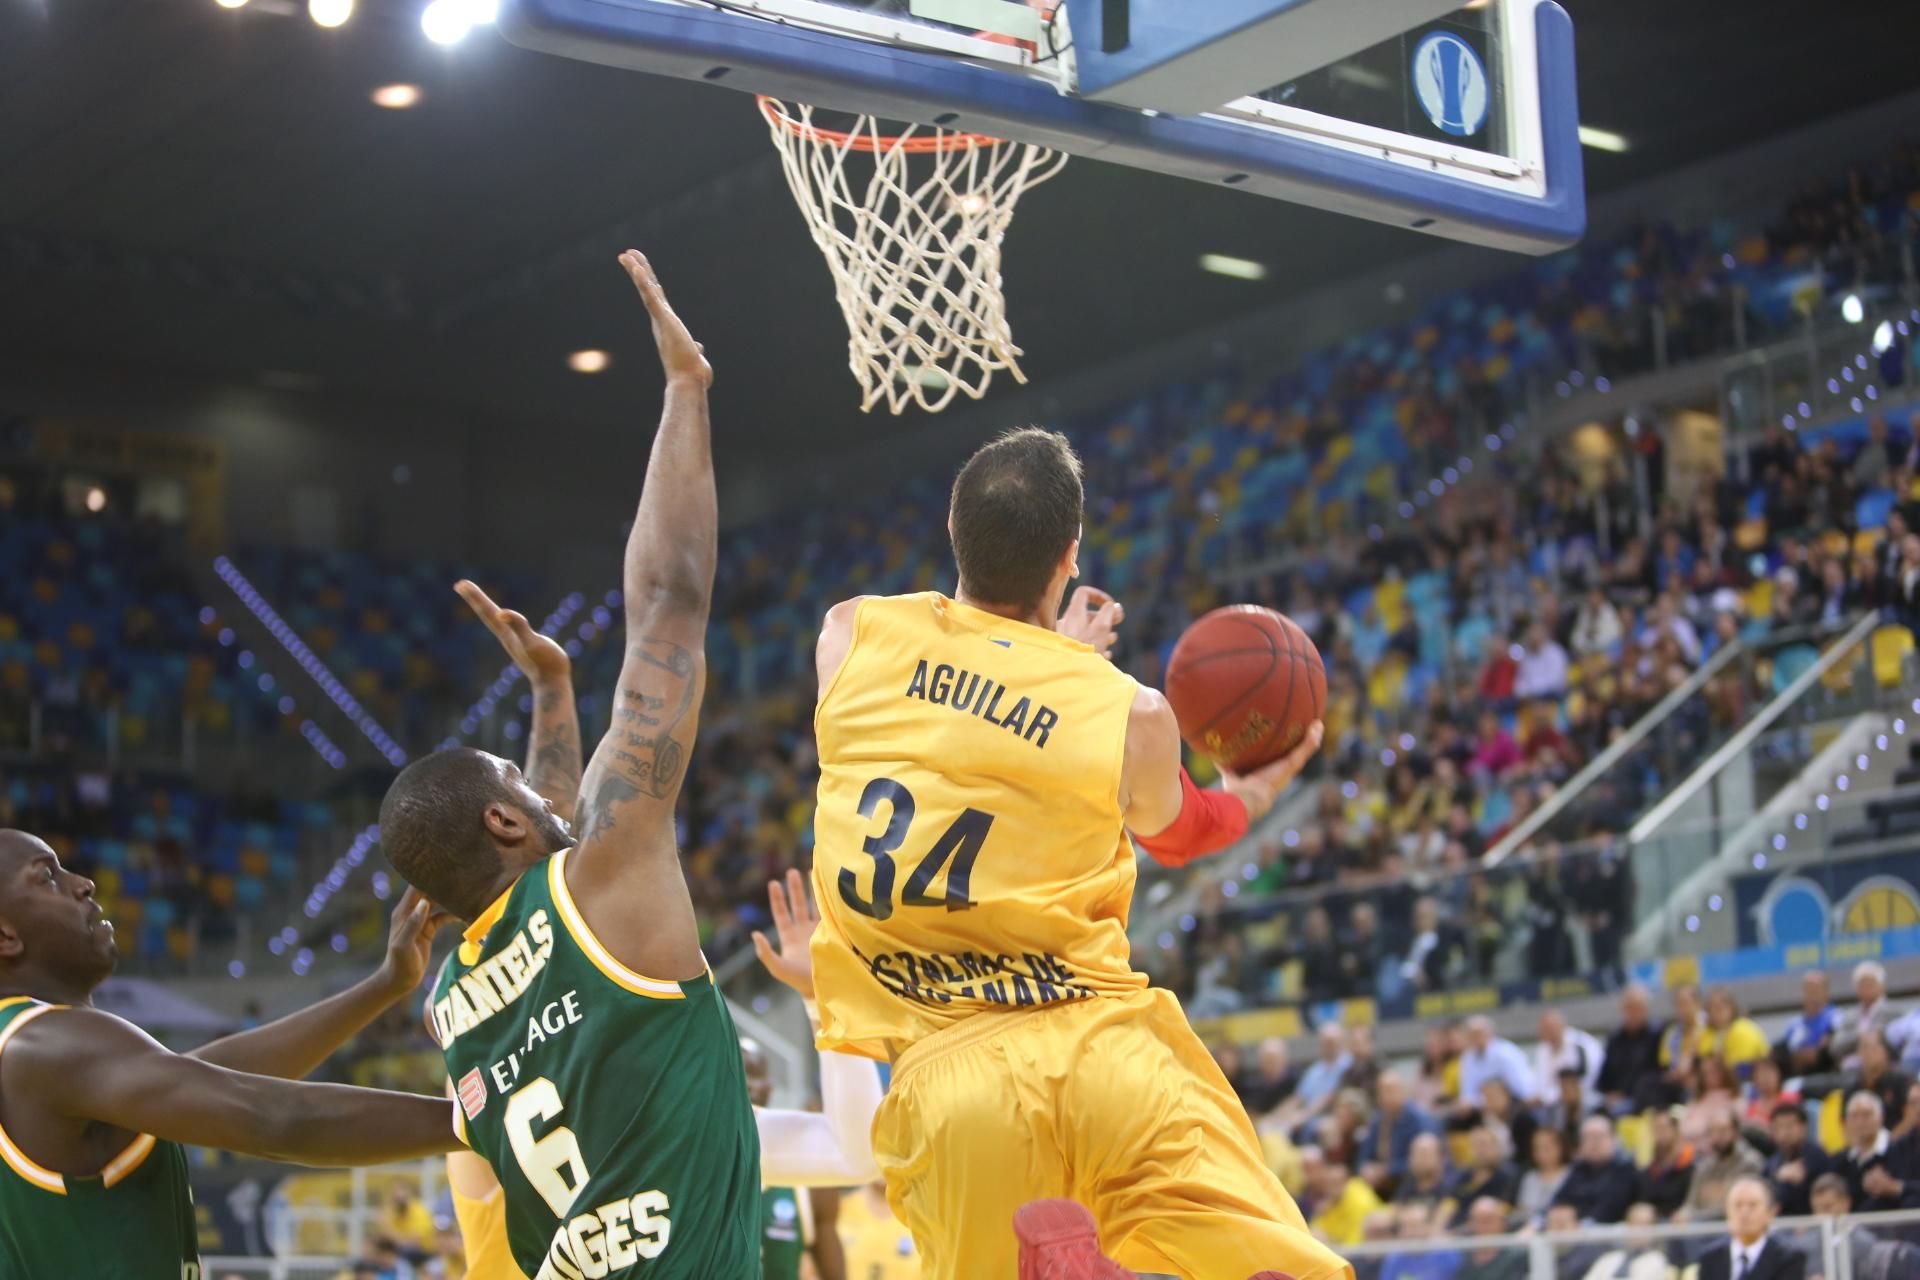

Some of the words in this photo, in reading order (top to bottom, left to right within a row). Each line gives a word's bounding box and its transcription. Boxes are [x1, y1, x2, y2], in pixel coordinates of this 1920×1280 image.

[906, 659, 1059, 750] AGUILAR
[837, 777, 995, 922] 34
[434, 908, 554, 1051] DANIELS
[1022, 952, 1076, 984] DE
[490, 989, 583, 1095] EIAGE
[503, 1076, 590, 1220] 6
